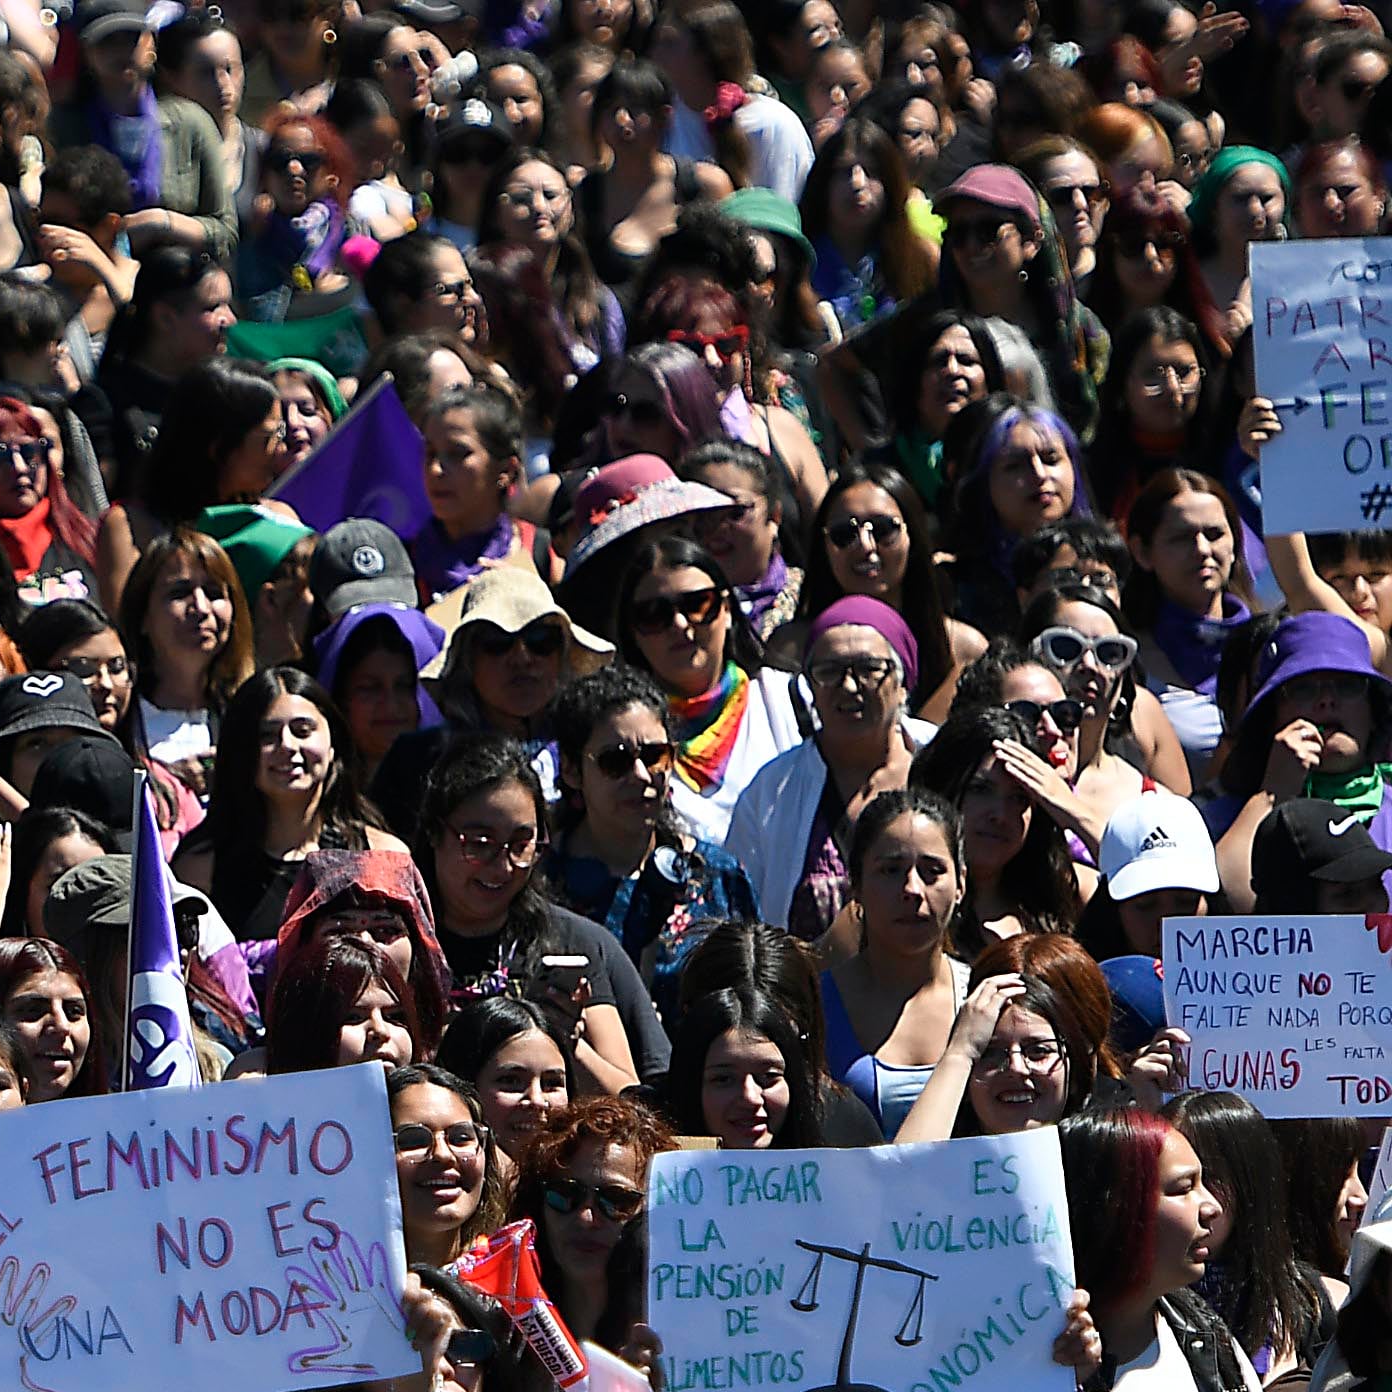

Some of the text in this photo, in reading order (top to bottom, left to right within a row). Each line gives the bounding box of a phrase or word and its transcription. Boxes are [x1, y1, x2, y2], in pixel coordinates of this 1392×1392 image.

[1176, 927, 1314, 963] MARCHA
[1175, 967, 1377, 998] AUNQUE NO TE
[1182, 1004, 1253, 1030] FALTE
[1268, 1007, 1321, 1028] NADA
[1304, 1037, 1337, 1052] LES
[1344, 1046, 1385, 1060] FALTA
[655, 1161, 823, 1207] NO PAGAR
[973, 1155, 1019, 1196] ES
[155, 1197, 341, 1275] NO ES
[678, 1219, 726, 1252] LA
[23, 1279, 331, 1363] UNA MODA
[726, 1306, 760, 1338] DE
